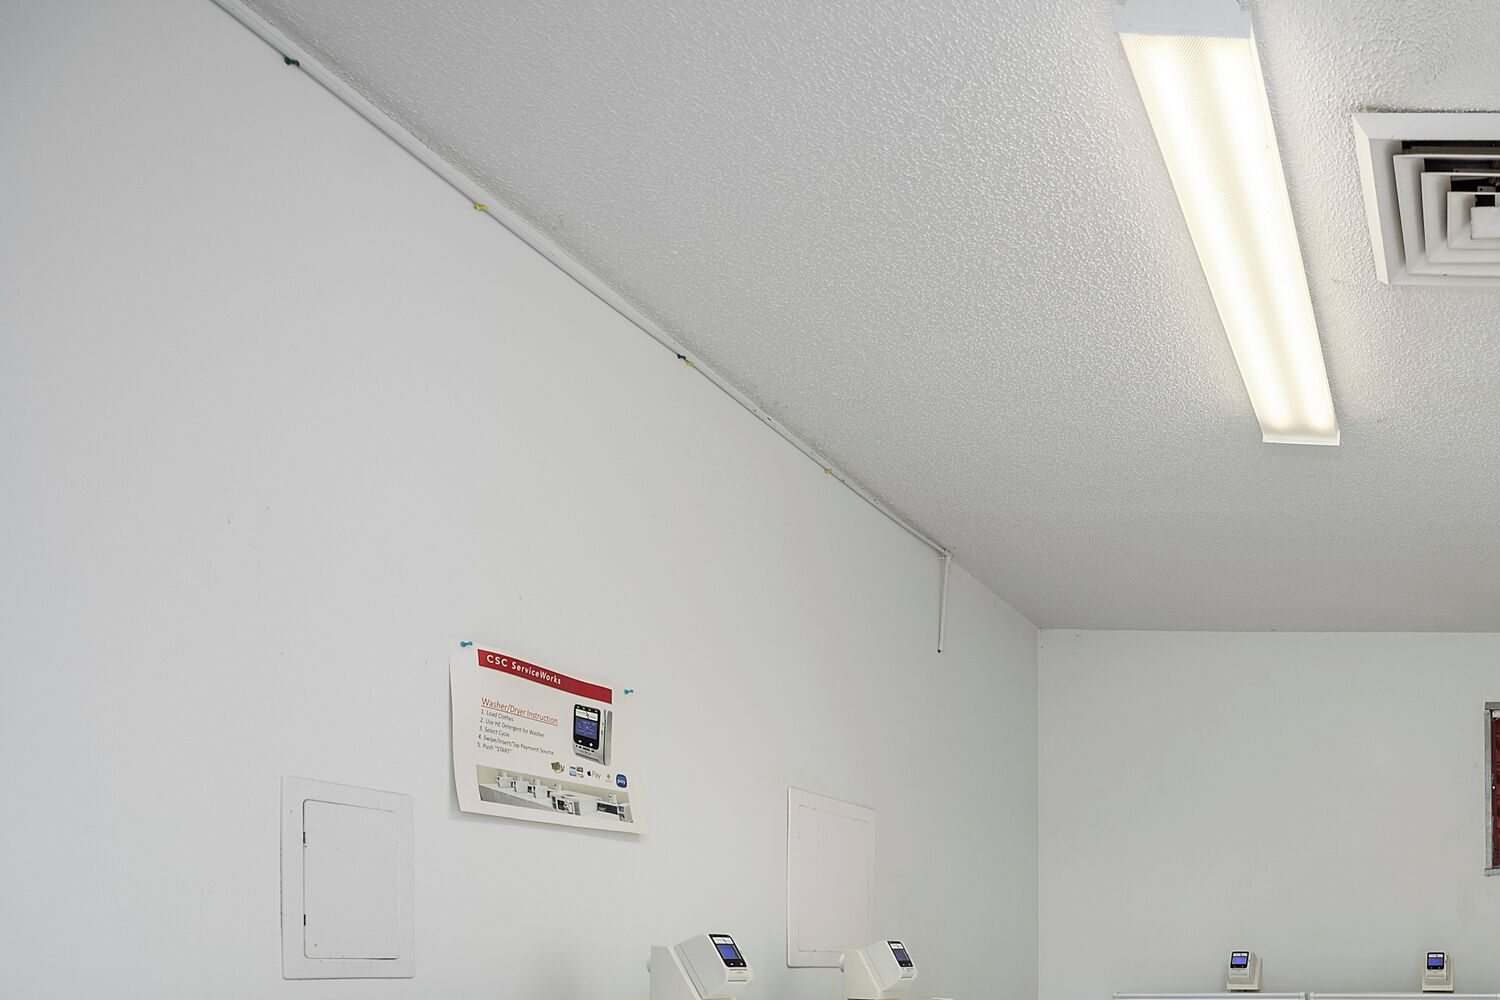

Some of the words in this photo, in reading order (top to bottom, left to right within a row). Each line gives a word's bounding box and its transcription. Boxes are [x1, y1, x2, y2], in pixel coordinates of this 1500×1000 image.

[486, 654, 508, 667] CSC
[511, 661, 561, 685] ServiceWorks
[481, 697, 526, 716] Washer/Dryer
[527, 710, 559, 725] Instruction
[486, 710, 498, 718] Load
[484, 727, 498, 735] Select
[502, 723, 522, 732] Detergent
[529, 729, 545, 738] Washer
